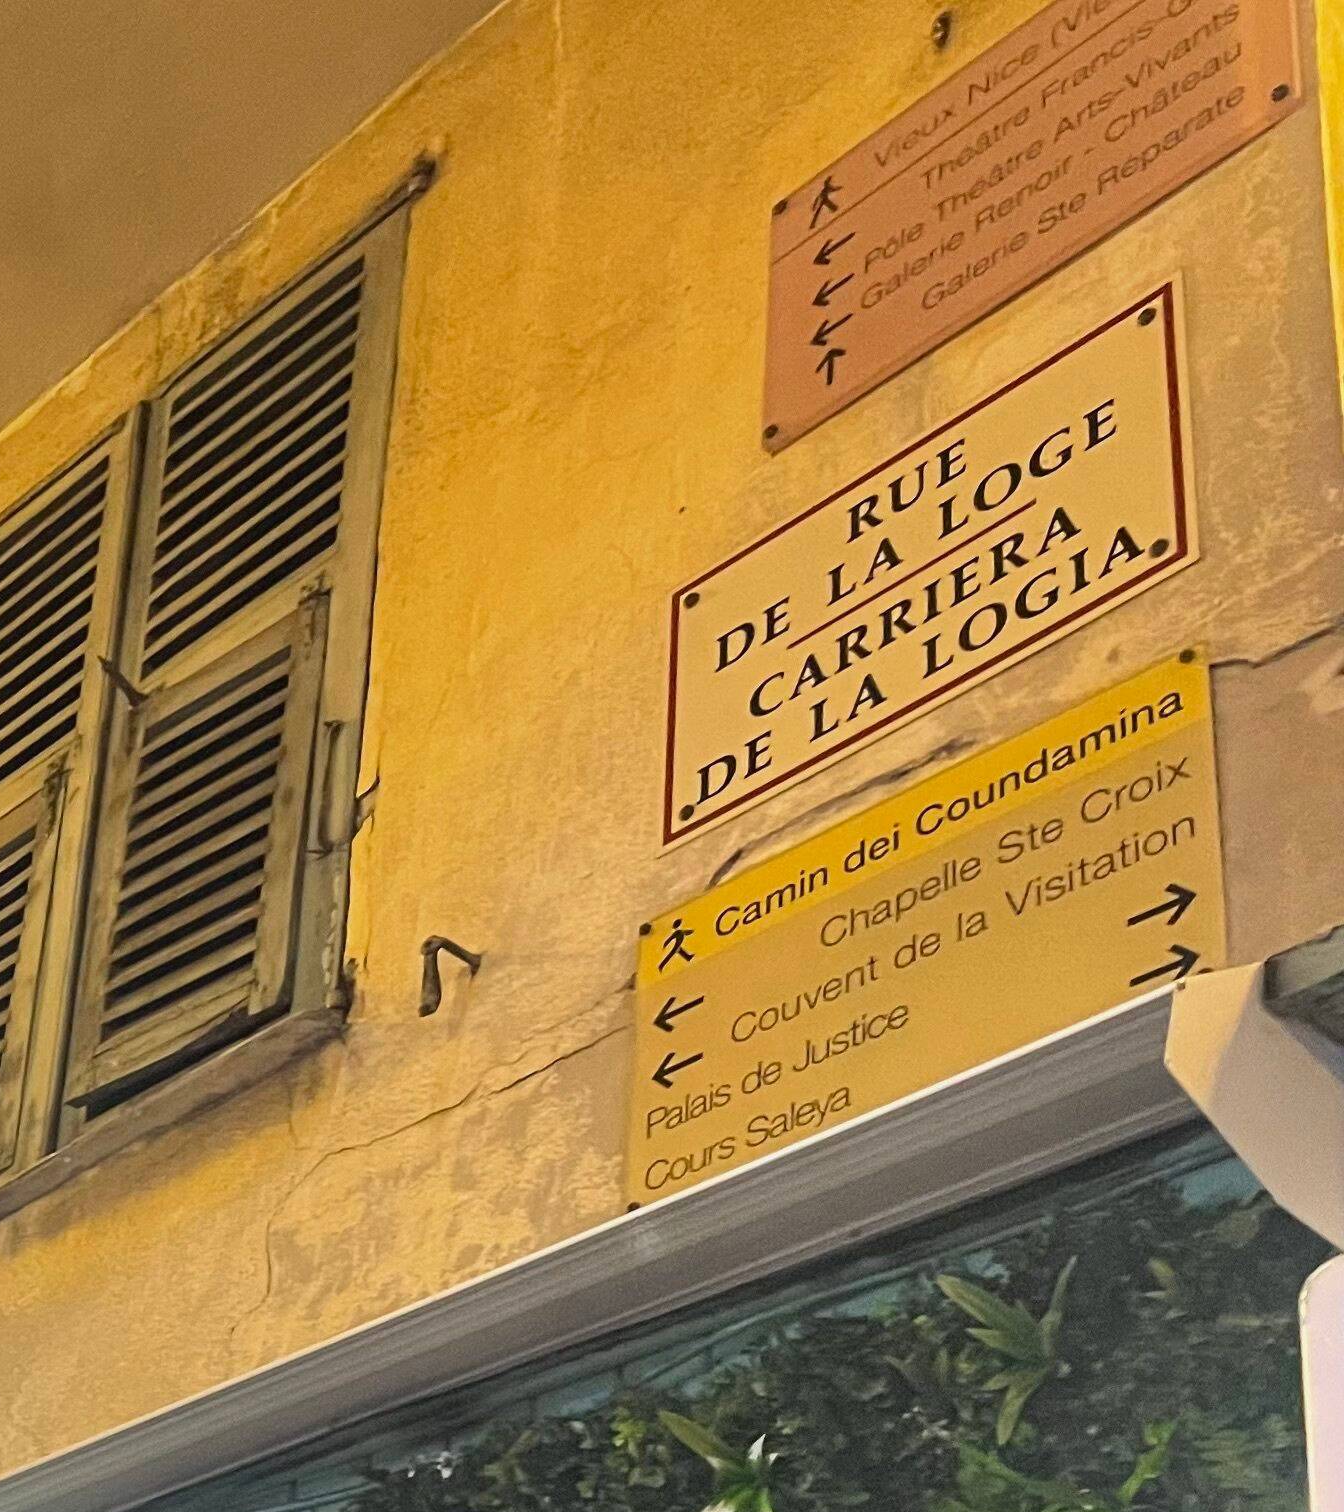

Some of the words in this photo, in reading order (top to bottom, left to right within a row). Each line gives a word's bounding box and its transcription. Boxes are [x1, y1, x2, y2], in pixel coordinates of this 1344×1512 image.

[874, 104, 954, 168] Vieux
[968, 43, 1040, 106] Nice
[861, 231, 964, 309] Galerie
[975, 154, 1072, 232] Renoir
[922, 231, 1027, 309] Galerie
[1038, 193, 1087, 235] Ste
[714, 597, 792, 673] DE
[827, 538, 905, 606] LA
[938, 399, 1118, 540] LOGE
[847, 438, 968, 543] RUE
[694, 731, 774, 805] DE
[809, 674, 888, 743] LA
[922, 526, 1145, 679] LOGIA
[749, 506, 1081, 717] CARRIERA
[714, 864, 830, 937] Camin
[843, 822, 902, 875] dei
[915, 689, 1184, 838] Coundamina
[819, 853, 983, 948] Chapelle
[997, 816, 1065, 865] Ste
[1081, 756, 1193, 825] Croix
[730, 959, 880, 1044] Couvent
[893, 925, 942, 967] de
[956, 909, 988, 945] la
[1004, 814, 1197, 917] Visitation
[644, 1082, 732, 1139] Palais
[740, 1058, 783, 1095] de
[792, 1003, 911, 1073] Justice
[644, 1134, 736, 1190] Cours
[746, 1085, 852, 1149] Saleya
